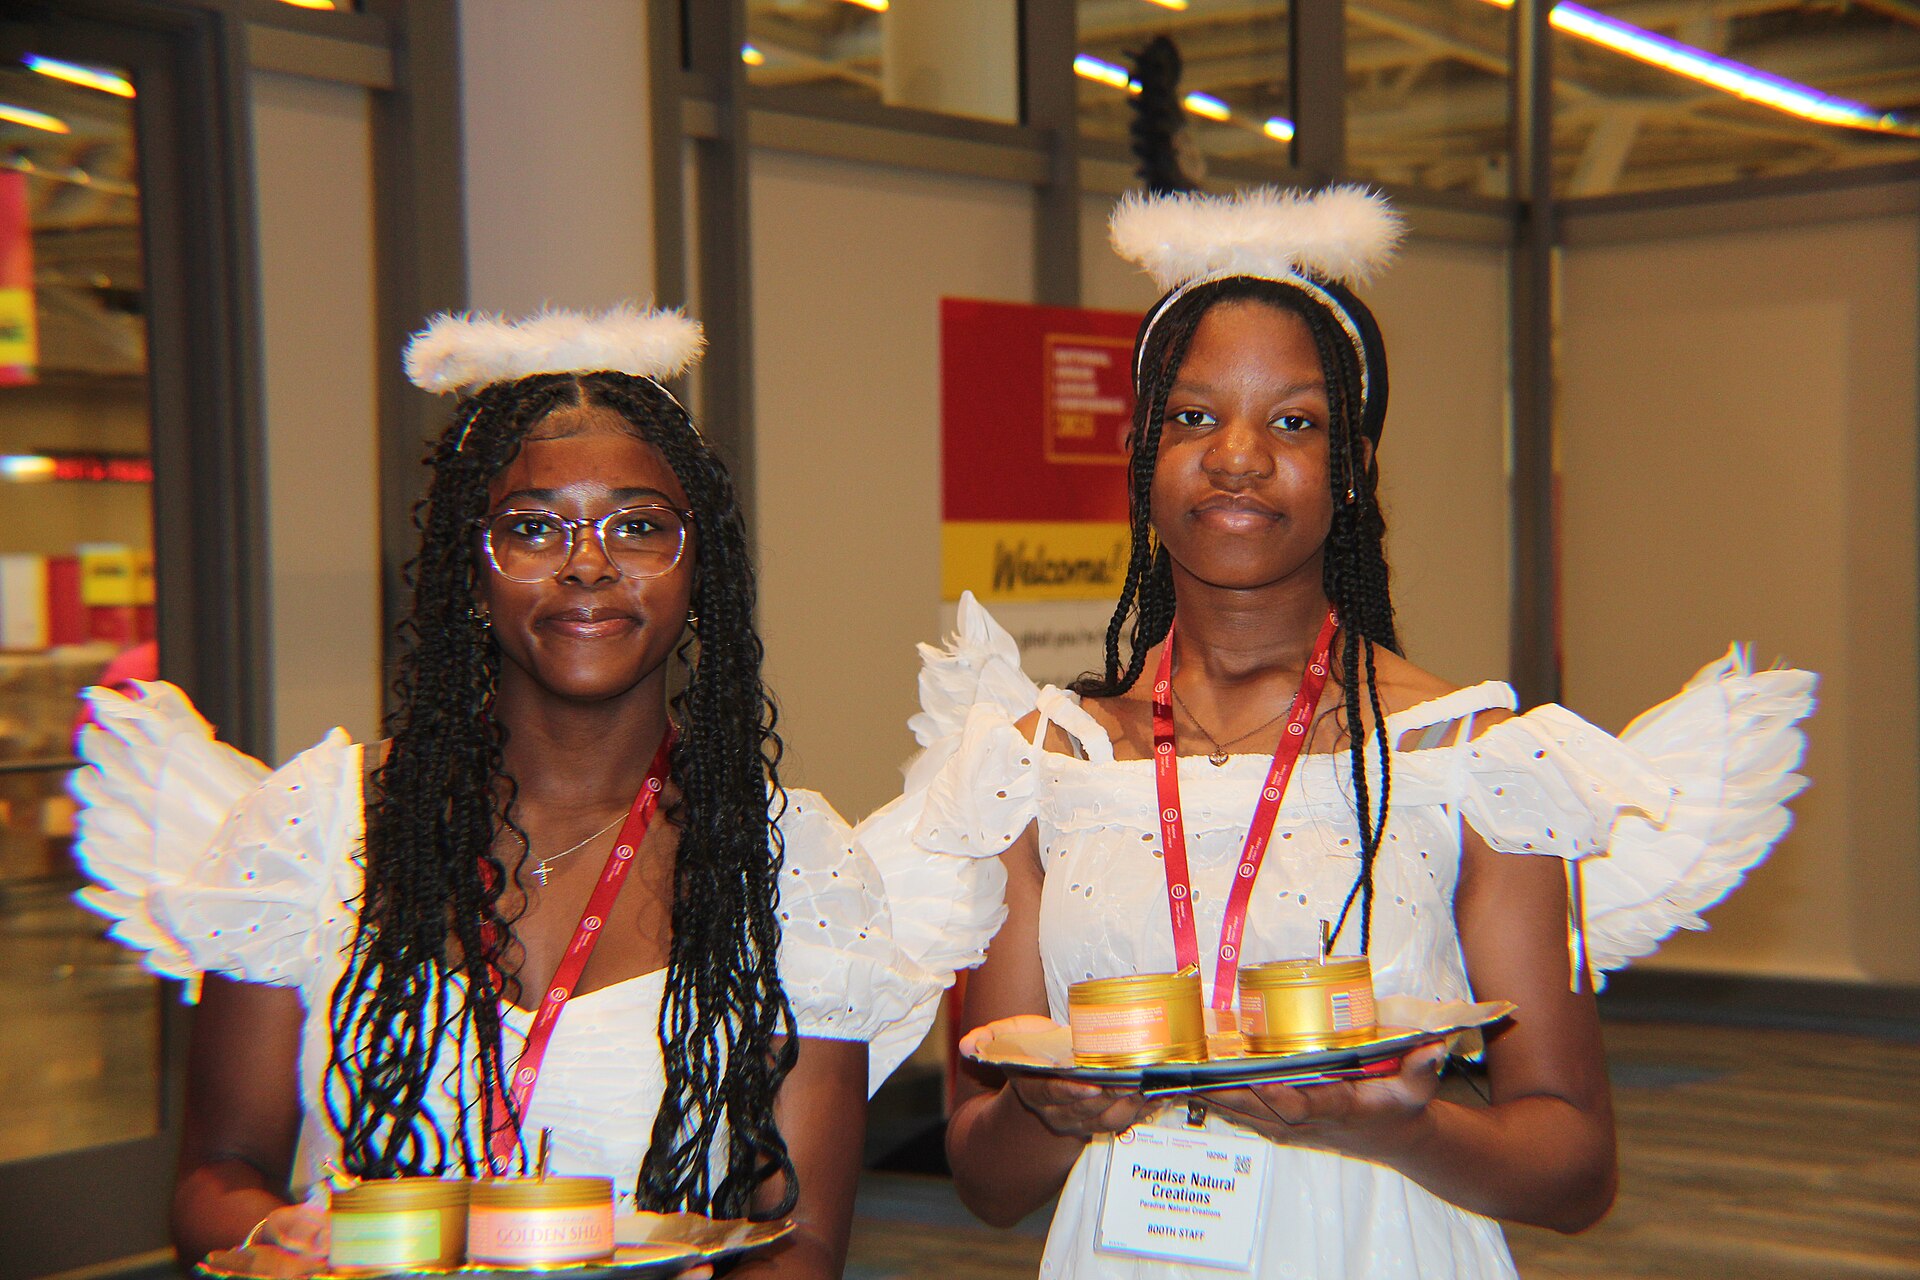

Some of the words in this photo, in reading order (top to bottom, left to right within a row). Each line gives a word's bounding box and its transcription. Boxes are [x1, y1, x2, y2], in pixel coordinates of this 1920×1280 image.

[993, 539, 1123, 591] Welcome!
[1131, 1163, 1186, 1185] Paradise
[1190, 1171, 1236, 1192] Natural
[1151, 1182, 1211, 1206] Creations
[1139, 1199, 1166, 1210] Paradise
[1167, 1202, 1191, 1214] Natural
[1191, 1205, 1221, 1218] Creations
[496, 1227, 568, 1243] GOLDEN
[1147, 1222, 1177, 1238] BOOTH
[1178, 1227, 1206, 1241] STAFF
